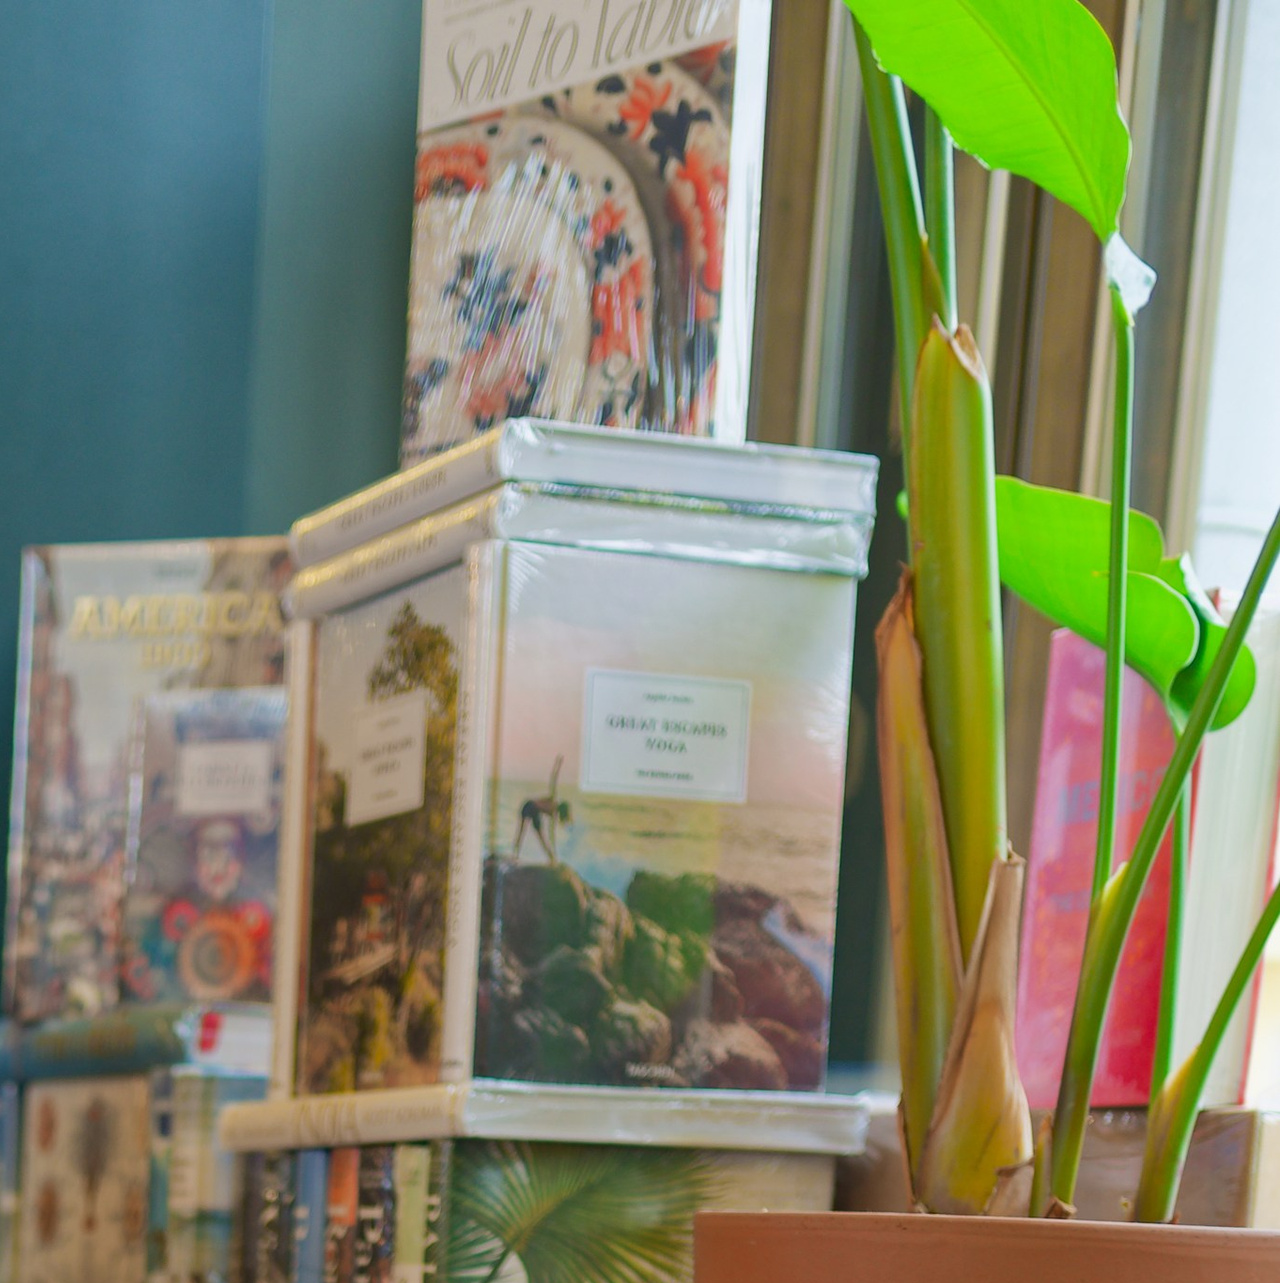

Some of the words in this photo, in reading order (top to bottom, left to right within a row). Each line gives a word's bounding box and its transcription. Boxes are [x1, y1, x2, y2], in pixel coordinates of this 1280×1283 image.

[446, 8, 532, 104] Soil
[528, 13, 579, 88] to
[72, 592, 286, 640] AMERICA
[606, 714, 656, 732] GREAT
[661, 720, 727, 738] ESCAPES
[645, 738, 687, 753] YOGA
[1056, 767, 1170, 826] MEICO
